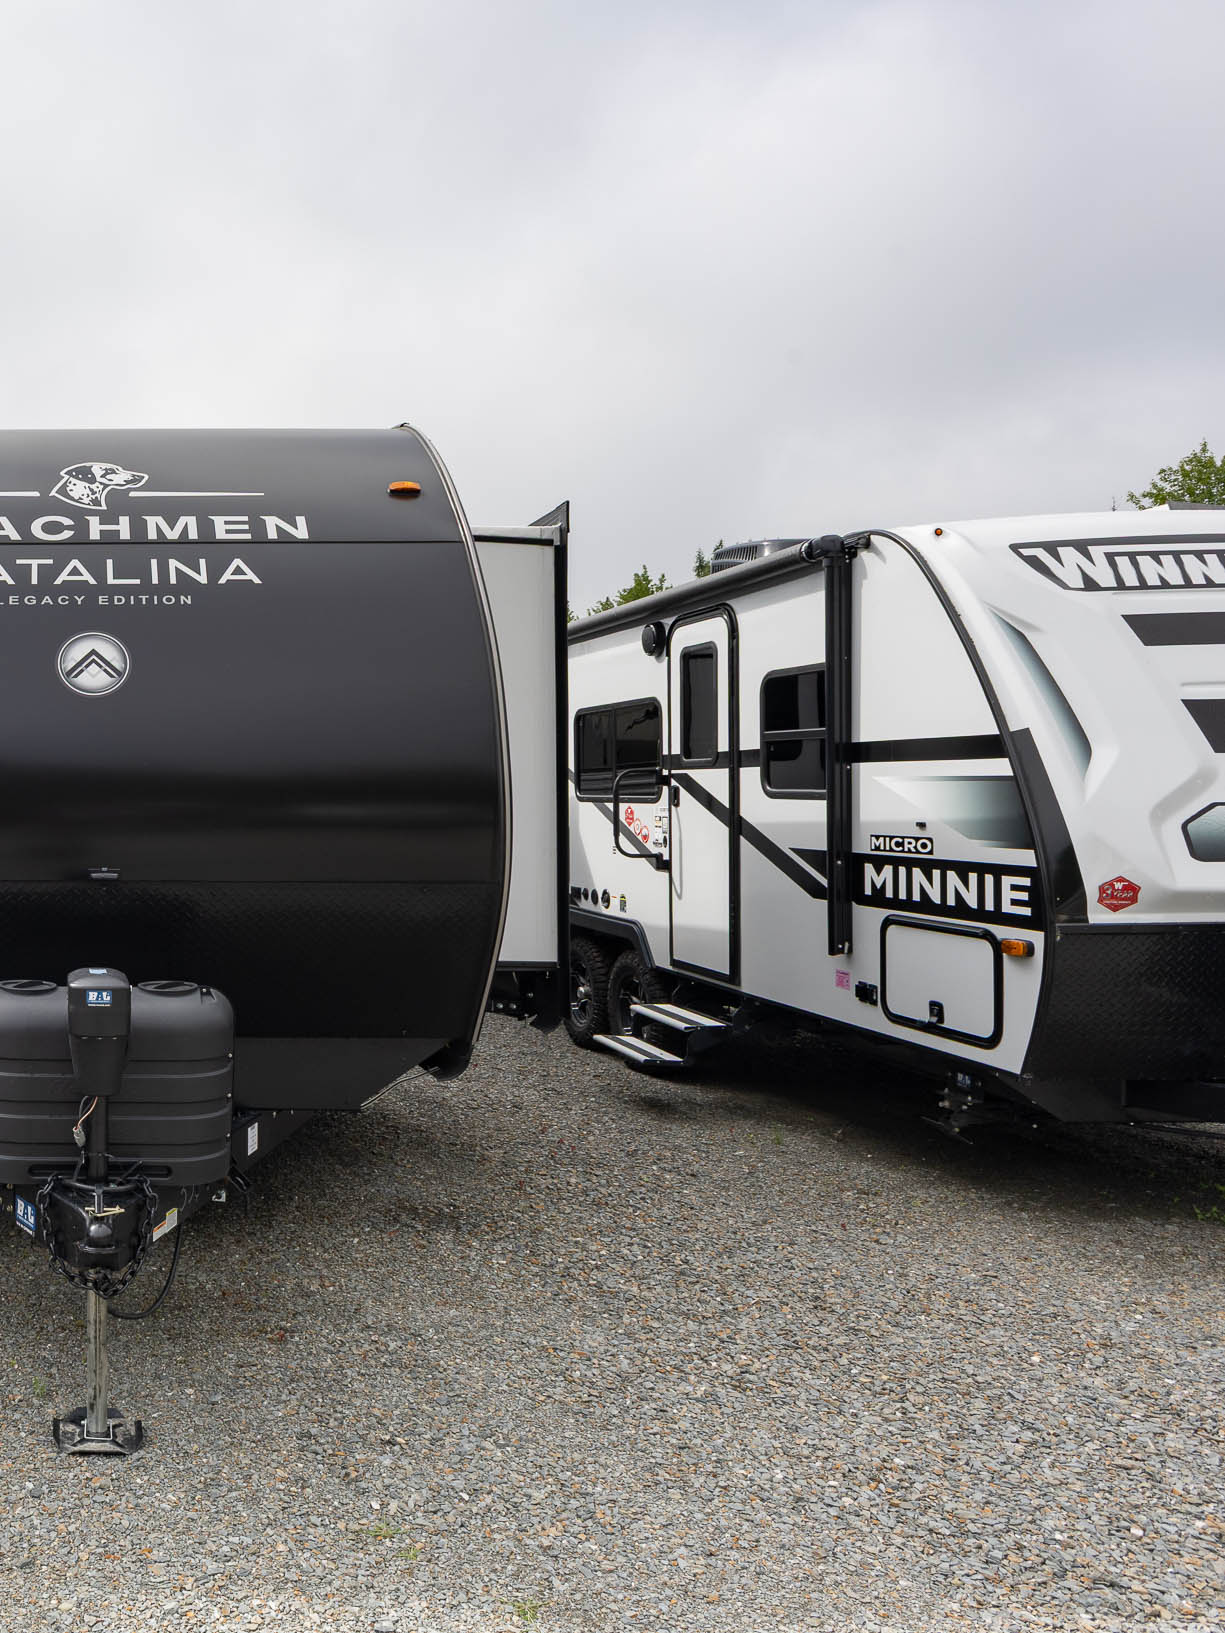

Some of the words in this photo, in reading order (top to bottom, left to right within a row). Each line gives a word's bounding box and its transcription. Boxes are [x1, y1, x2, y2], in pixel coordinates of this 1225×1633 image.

[98, 595, 192, 605] EDITION
[871, 836, 932, 853] MICRO
[863, 862, 1032, 916] MINNIE
